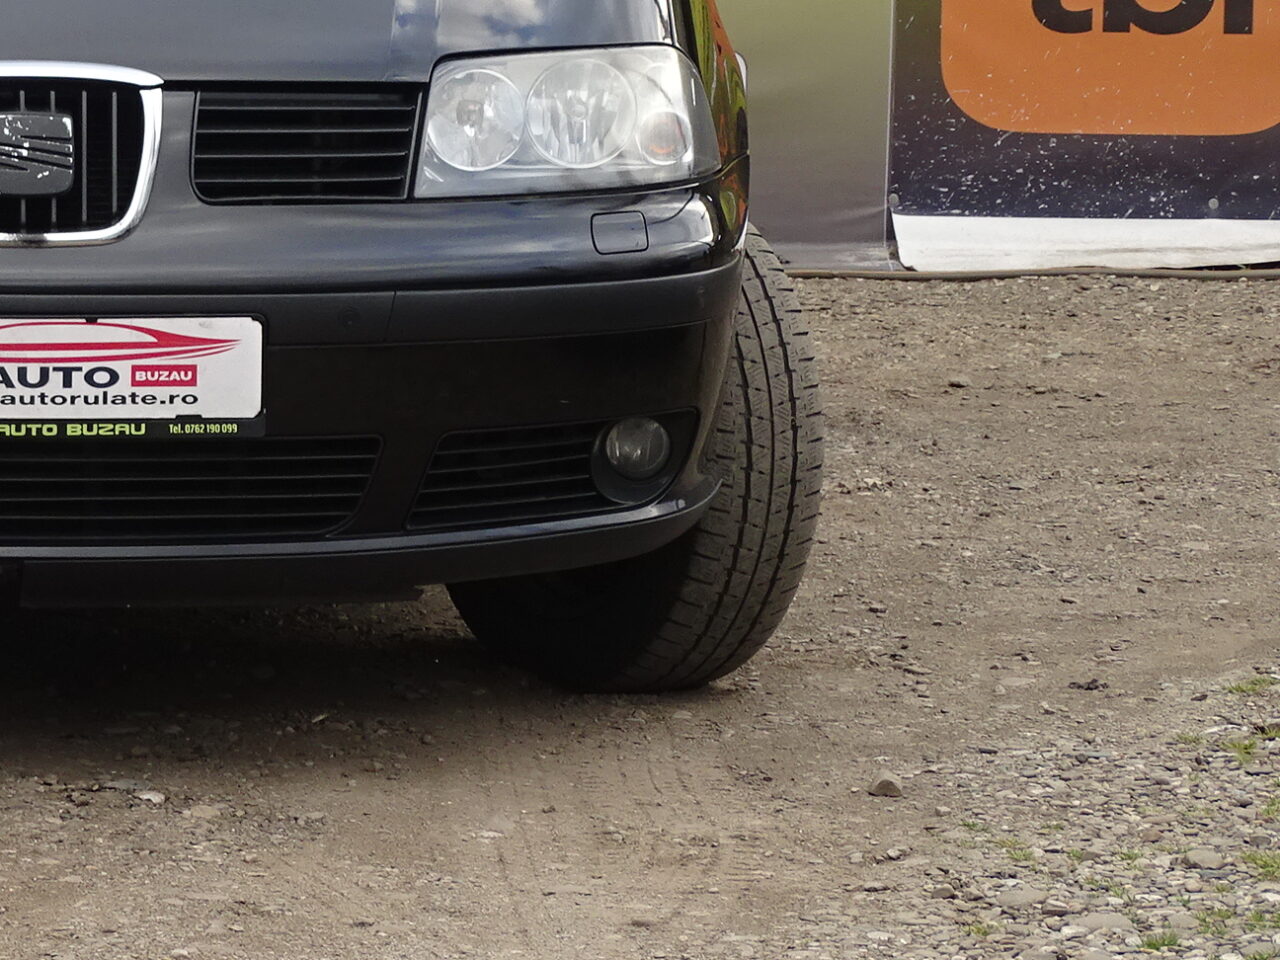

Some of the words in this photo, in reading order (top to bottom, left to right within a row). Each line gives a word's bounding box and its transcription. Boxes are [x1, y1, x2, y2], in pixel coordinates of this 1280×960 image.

[135, 370, 193, 382] BUZAU
[67, 423, 146, 436] BUZAU
[169, 424, 184, 434] Tel.
[185, 424, 205, 434] 0762
[206, 424, 220, 434] 190
[222, 424, 238, 434] 099
